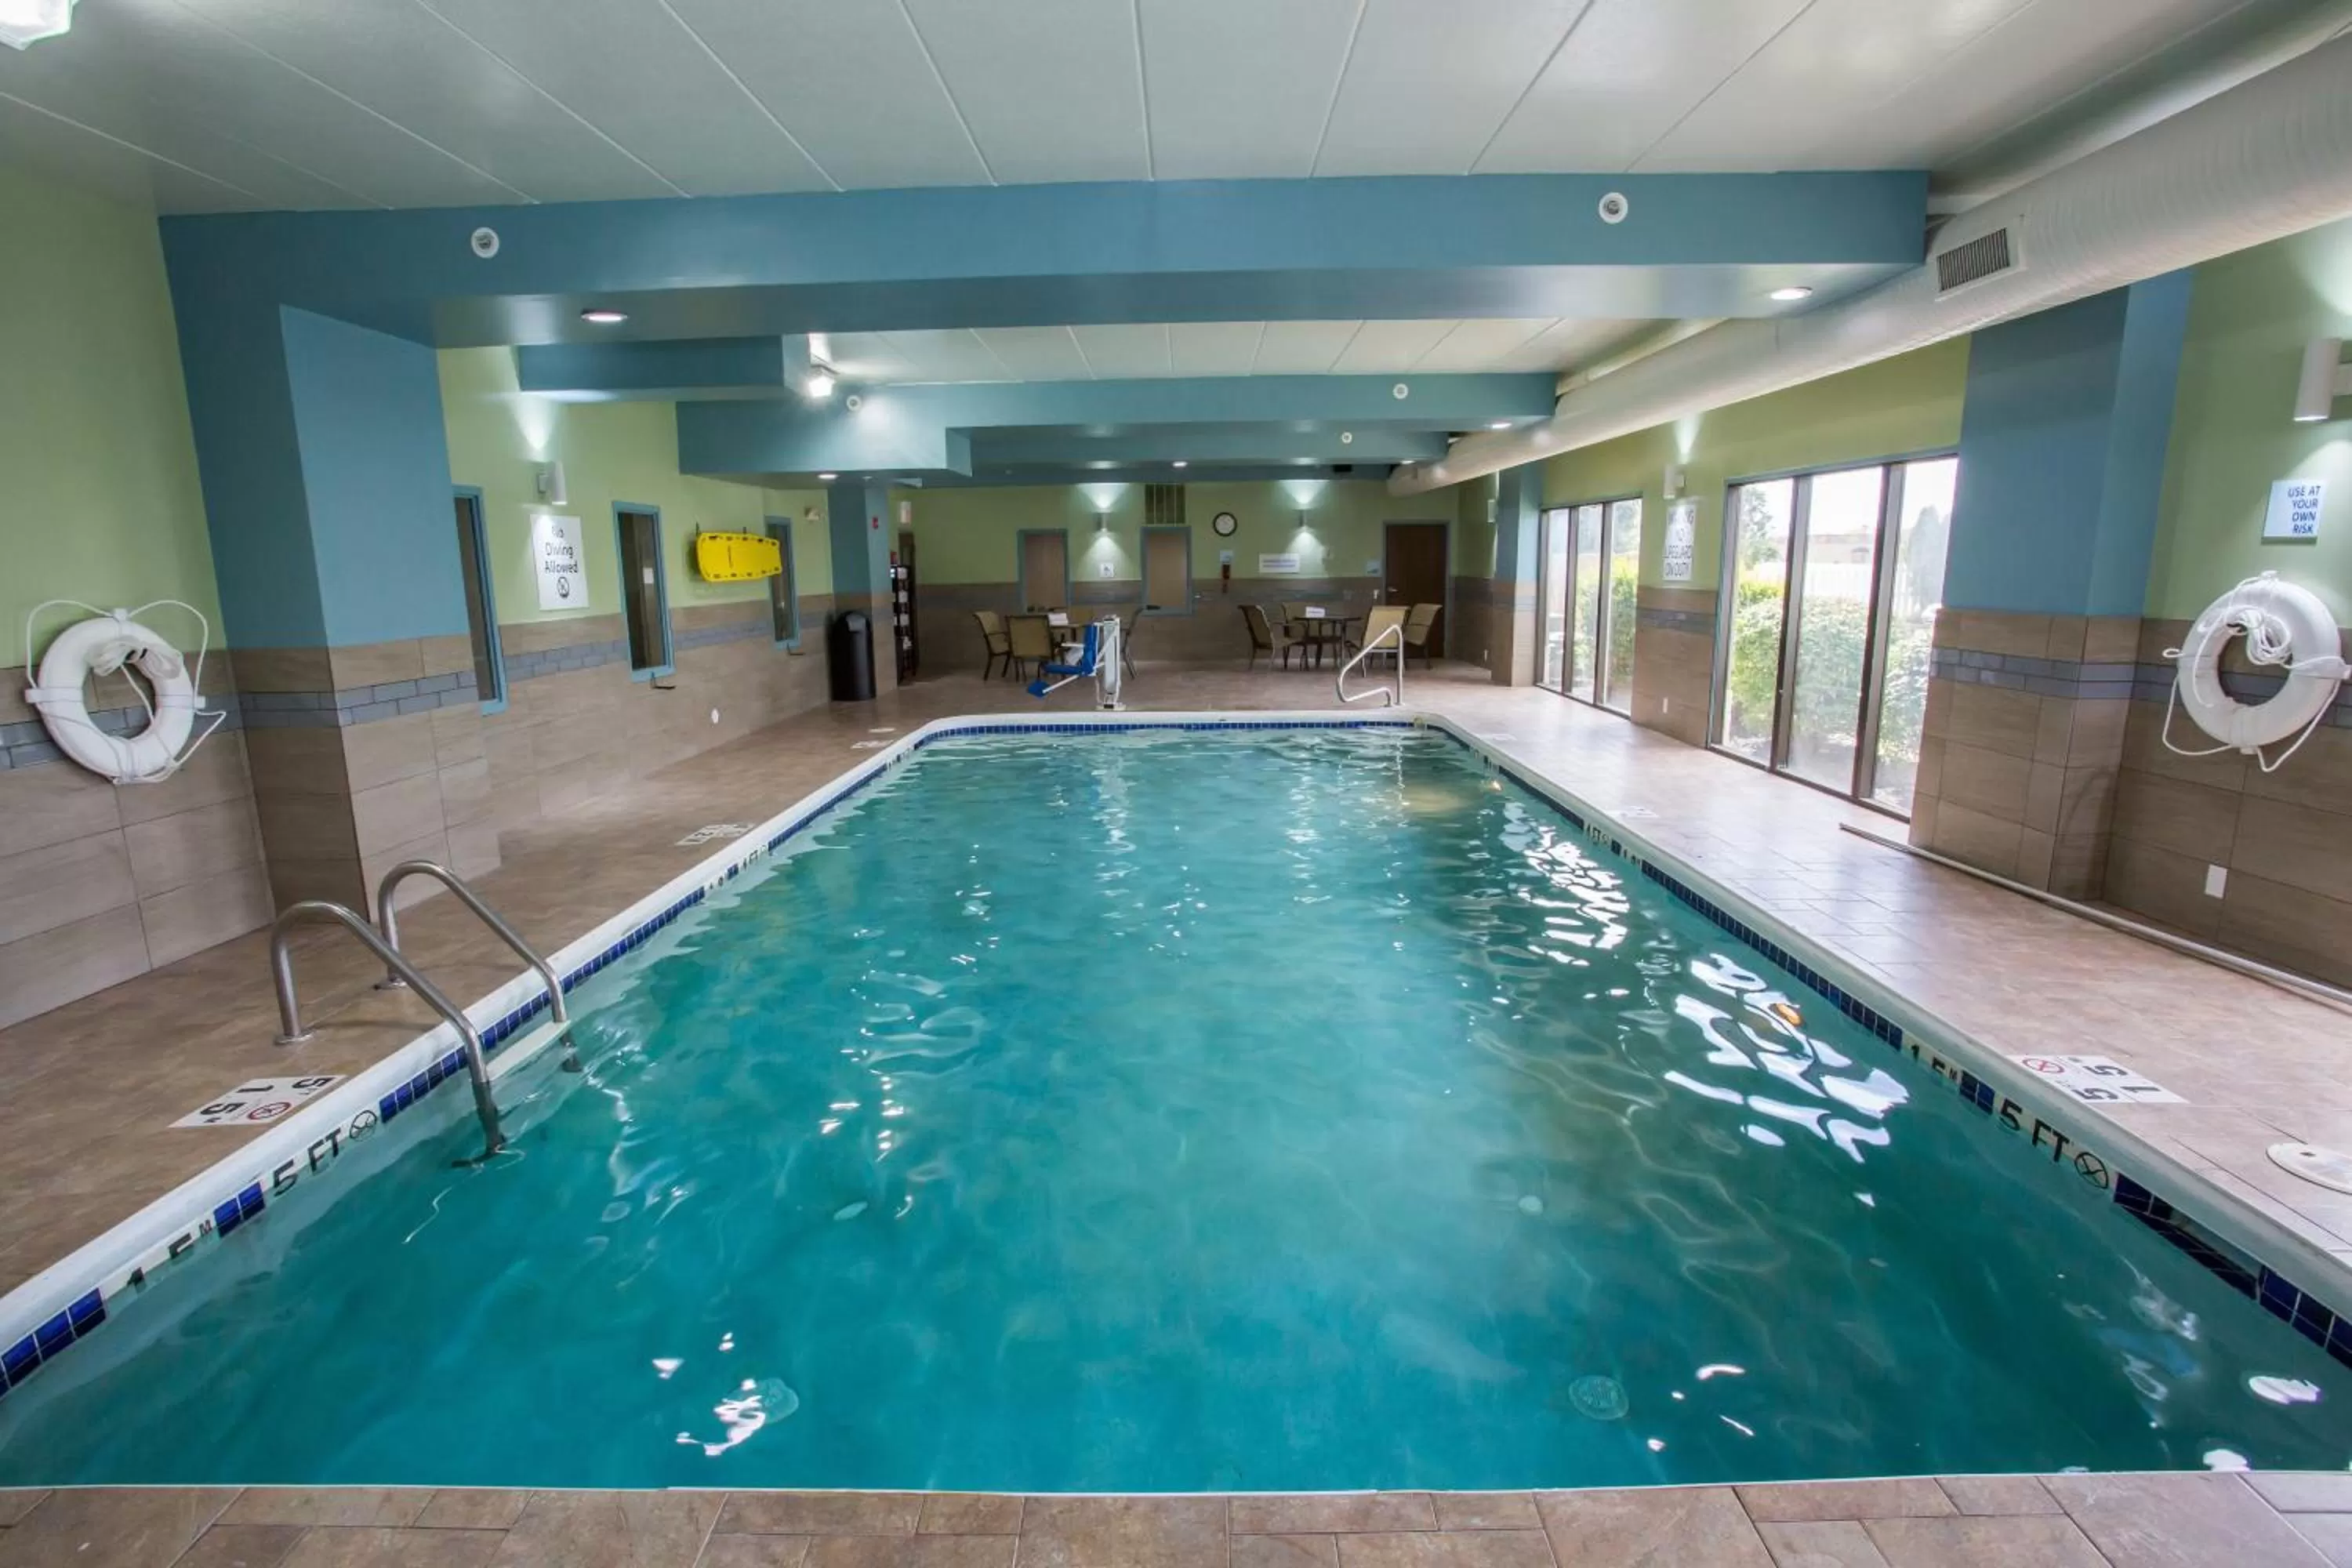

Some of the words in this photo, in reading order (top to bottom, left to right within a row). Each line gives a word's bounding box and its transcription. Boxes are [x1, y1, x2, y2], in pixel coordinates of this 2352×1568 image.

[2288, 486, 2305, 497] USE
[2308, 485, 2321, 496] AT
[2292, 499, 2318, 509] YOUR
[2292, 512, 2317, 522] OWN
[2293, 524, 2314, 534] RISK
[545, 542, 573, 558] Diving
[545, 561, 579, 573] Allowed
[2000, 1098, 2023, 1131] 5
[2031, 1118, 2071, 1163] FT
[307, 1127, 341, 1172] FT
